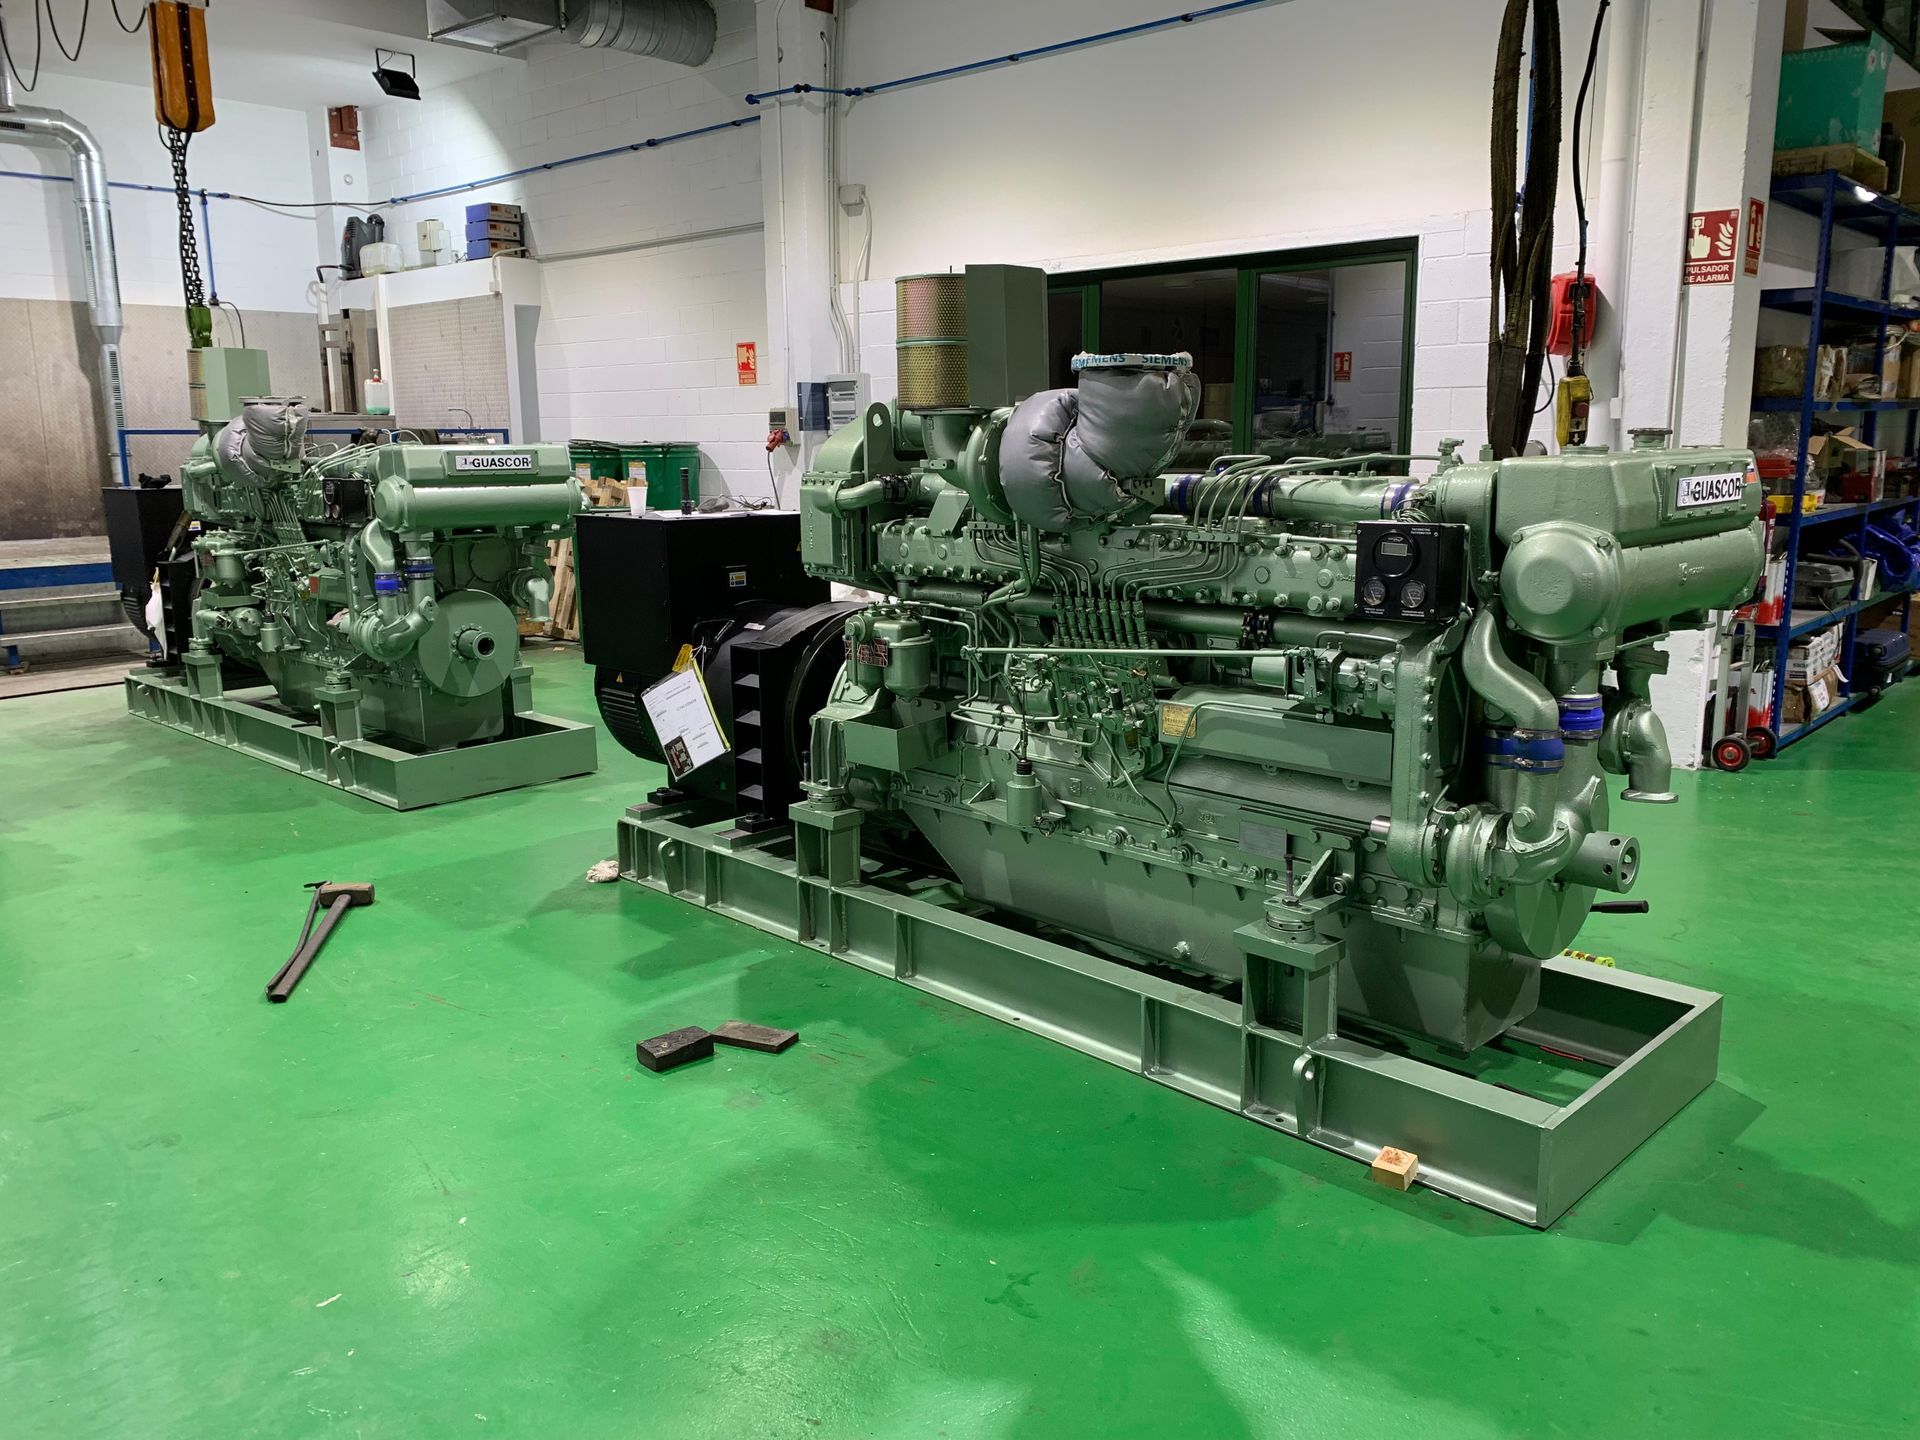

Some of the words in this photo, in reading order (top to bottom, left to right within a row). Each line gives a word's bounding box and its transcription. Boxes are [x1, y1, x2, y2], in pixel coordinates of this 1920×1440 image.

[1686, 264, 1729, 274] PULSADOR
[1696, 273, 1729, 282] ALARMA
[472, 457, 530, 468] GUASCOR
[1692, 477, 1741, 502] GUASCOR
